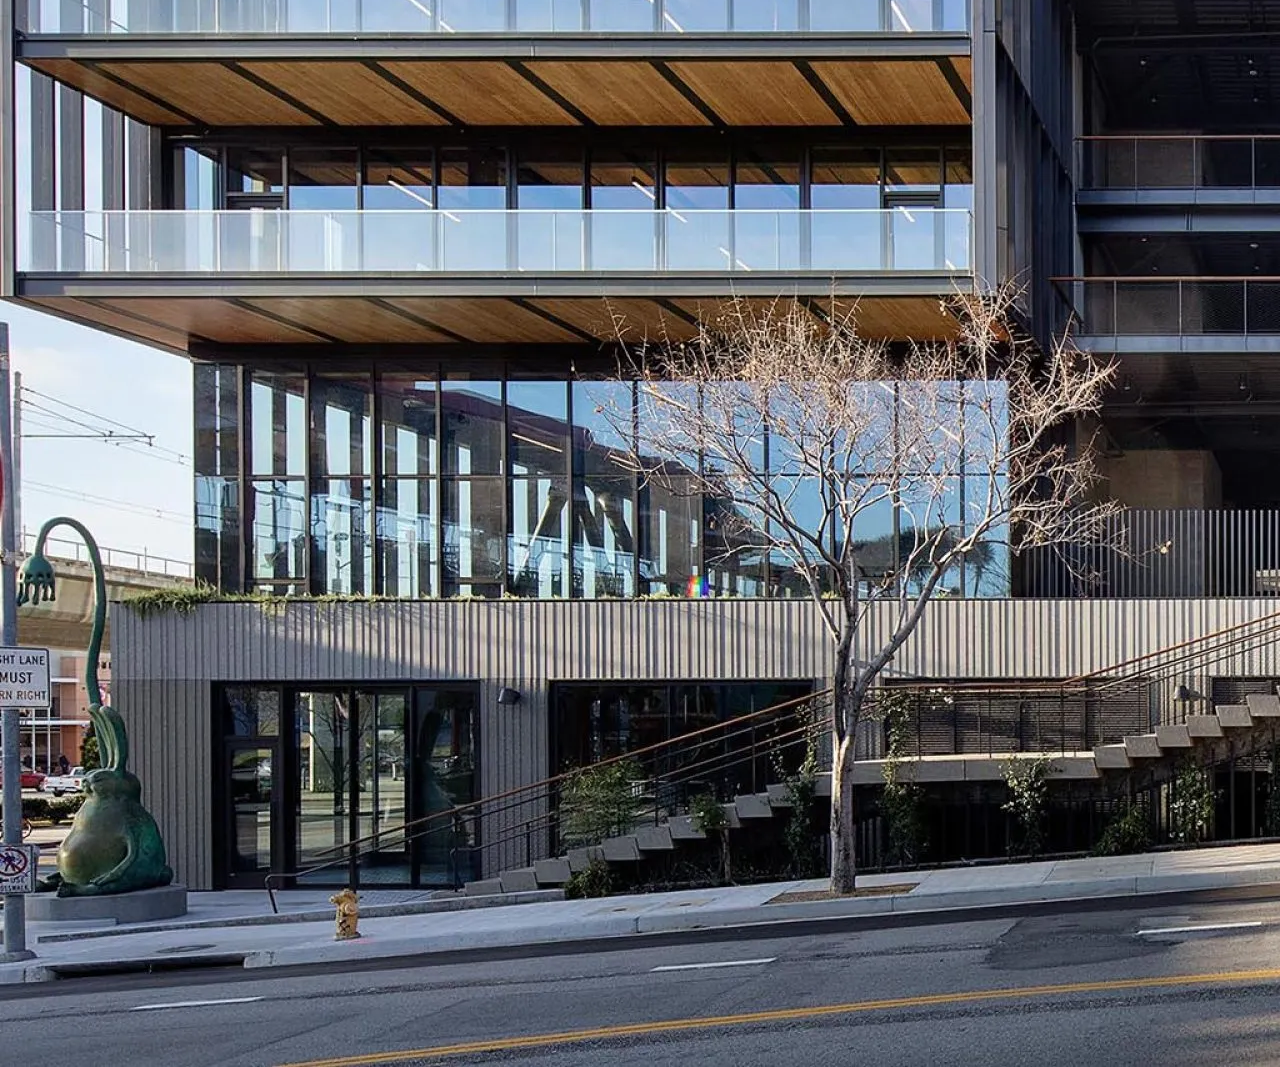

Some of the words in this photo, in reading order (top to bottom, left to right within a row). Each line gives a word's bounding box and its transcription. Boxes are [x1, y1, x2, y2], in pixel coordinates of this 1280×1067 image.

[20, 655, 45, 665] LANE
[0, 672, 32, 683] MUST
[17, 691, 46, 700] RIGHT
